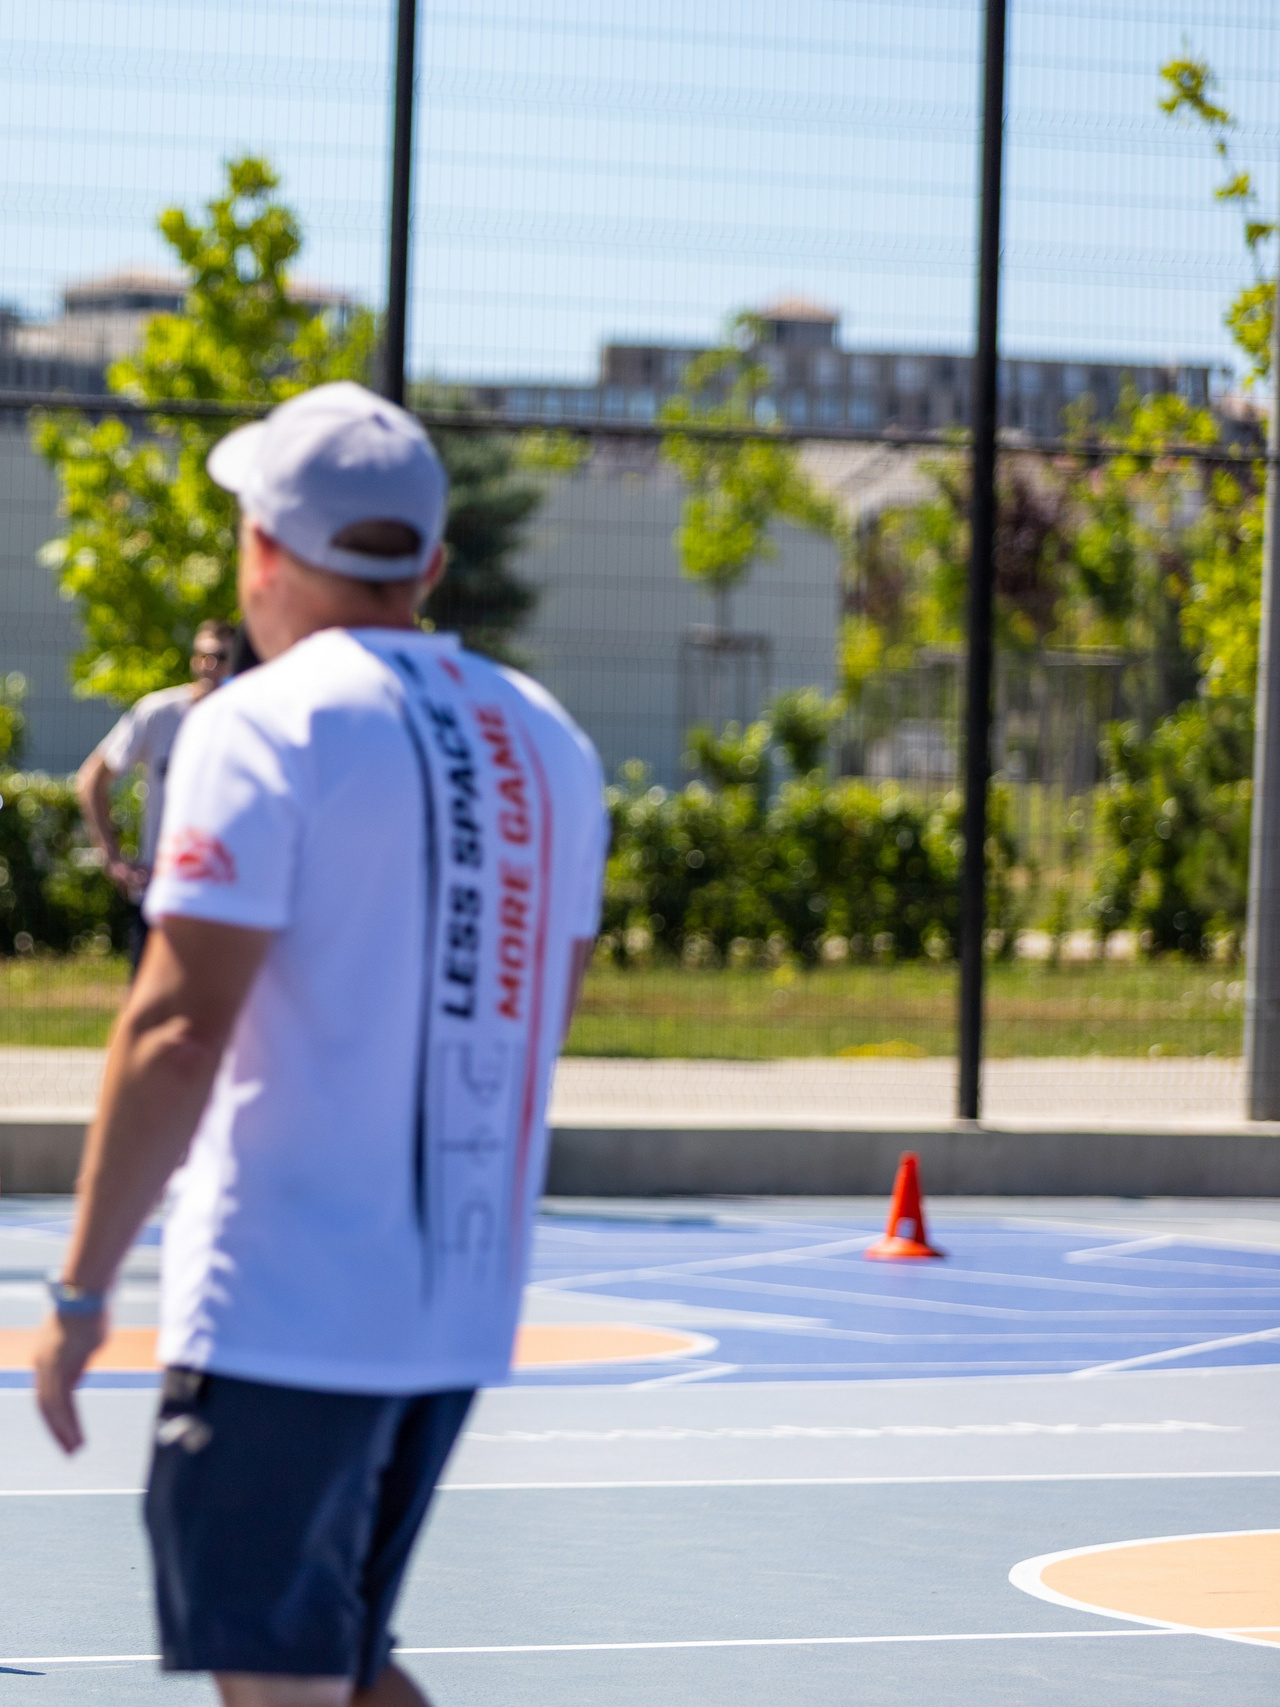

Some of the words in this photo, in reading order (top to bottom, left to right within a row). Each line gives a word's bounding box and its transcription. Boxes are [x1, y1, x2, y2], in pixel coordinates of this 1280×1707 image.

[422, 699, 483, 871] SPACE
[475, 701, 533, 846] GAME
[441, 882, 483, 1021] LESS
[496, 859, 534, 1022] MORE
